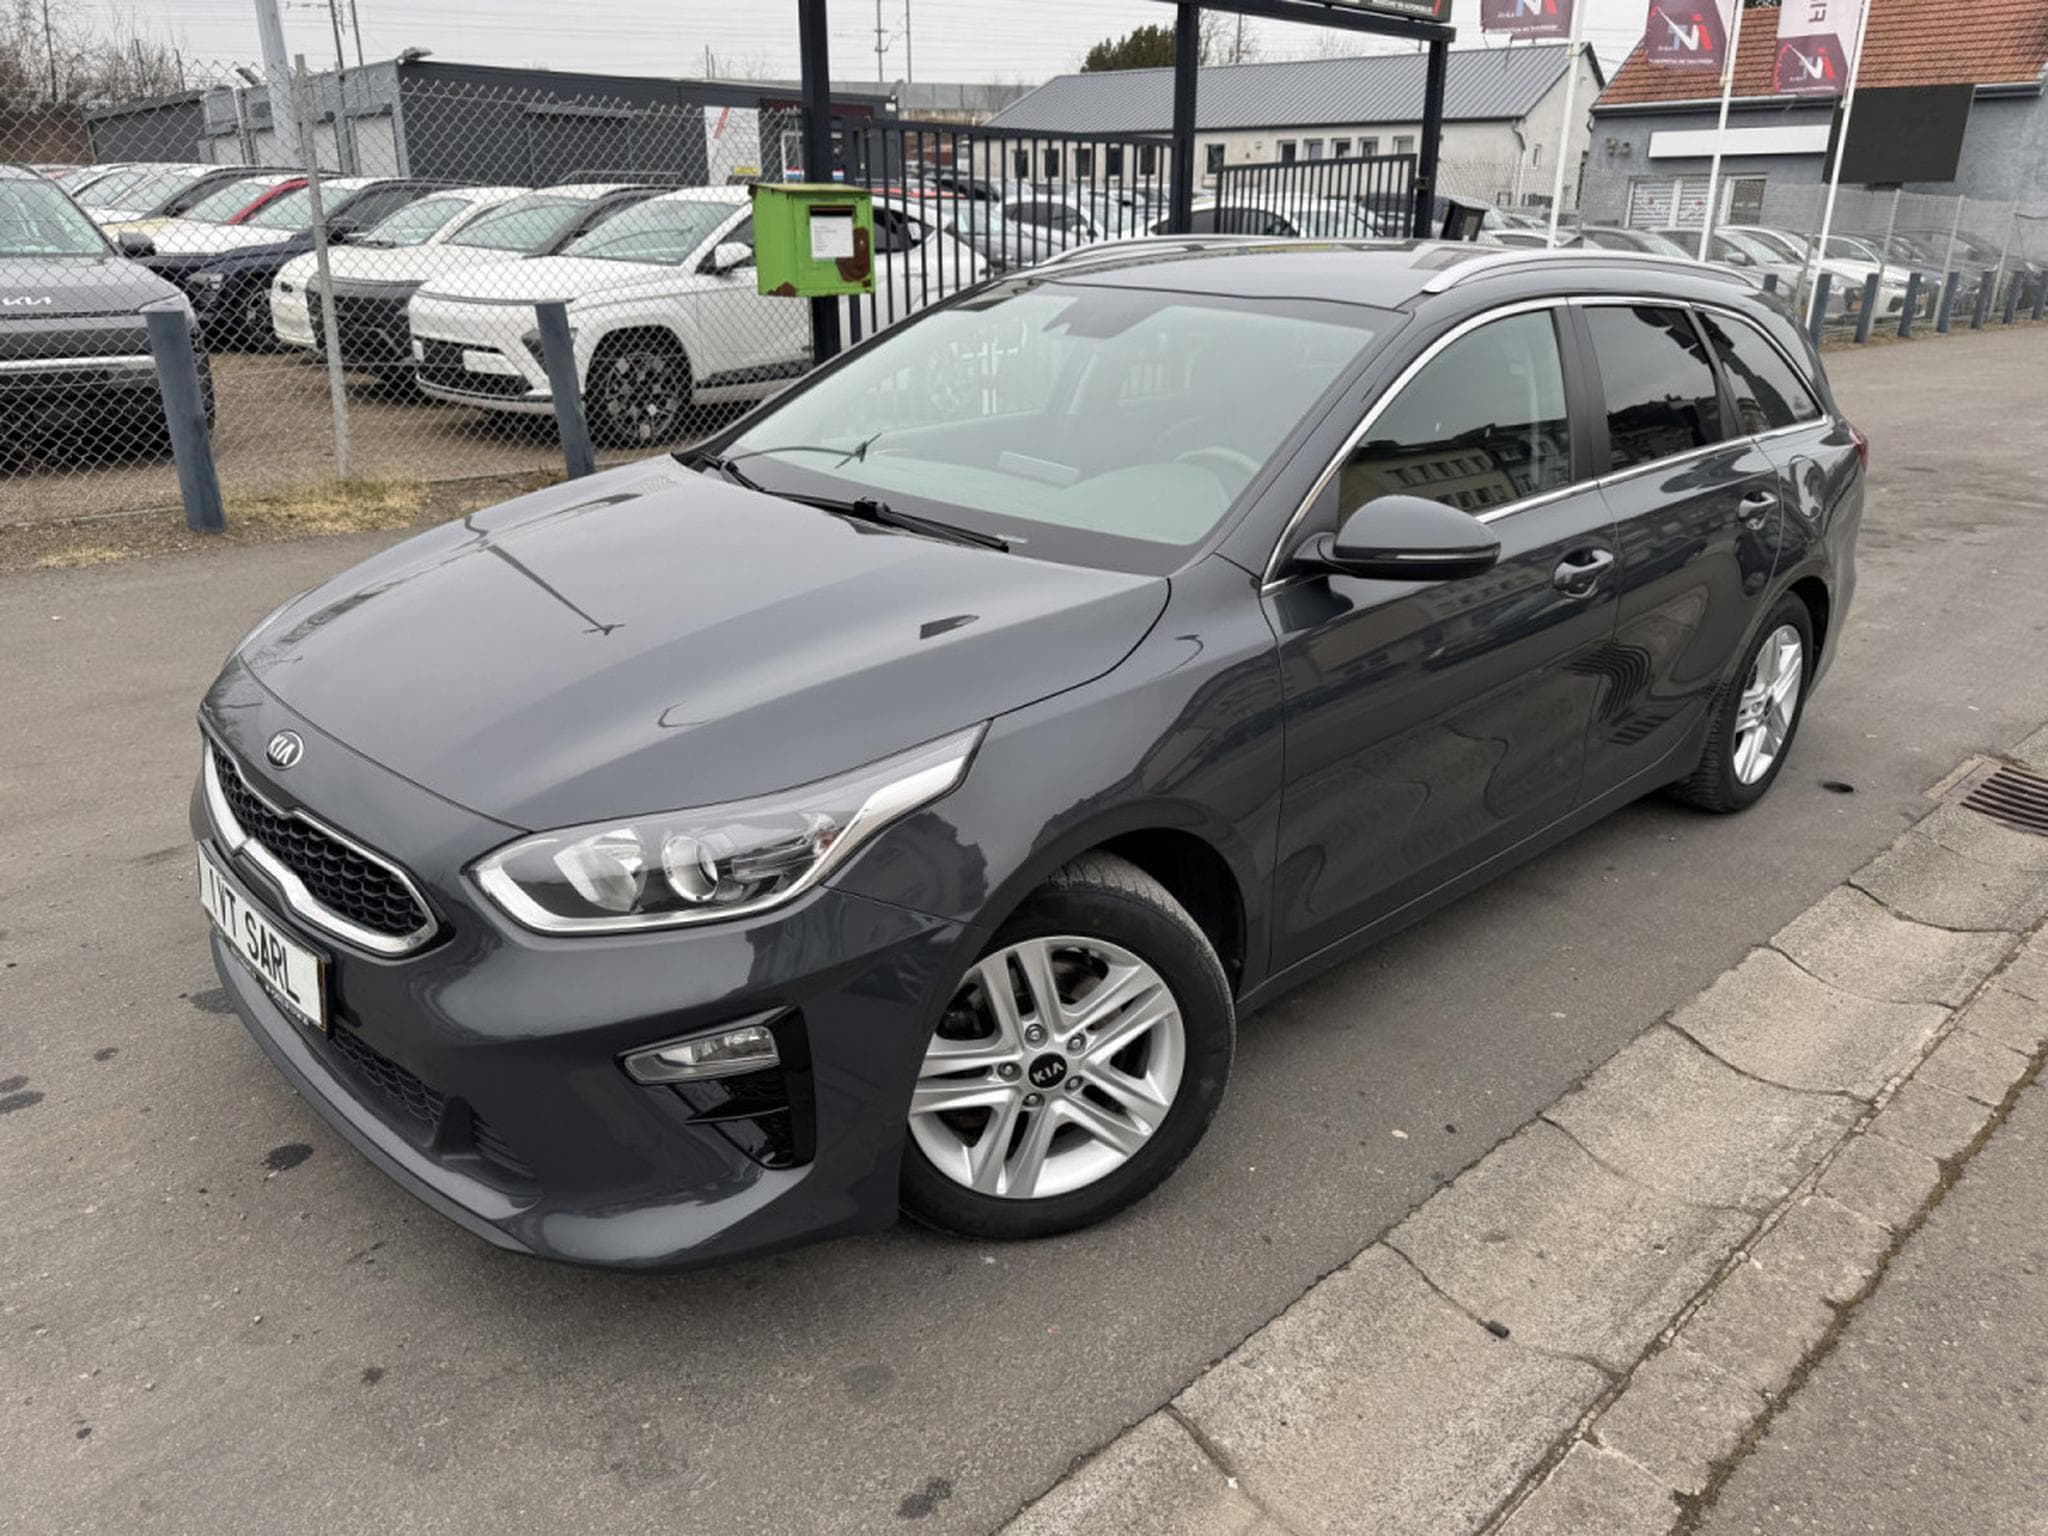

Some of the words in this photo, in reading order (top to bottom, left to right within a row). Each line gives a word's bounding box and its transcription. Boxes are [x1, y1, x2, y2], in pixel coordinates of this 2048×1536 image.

[269, 734, 296, 764] KIA
[245, 911, 301, 1004] SARL
[1032, 1061, 1065, 1083] KIA
